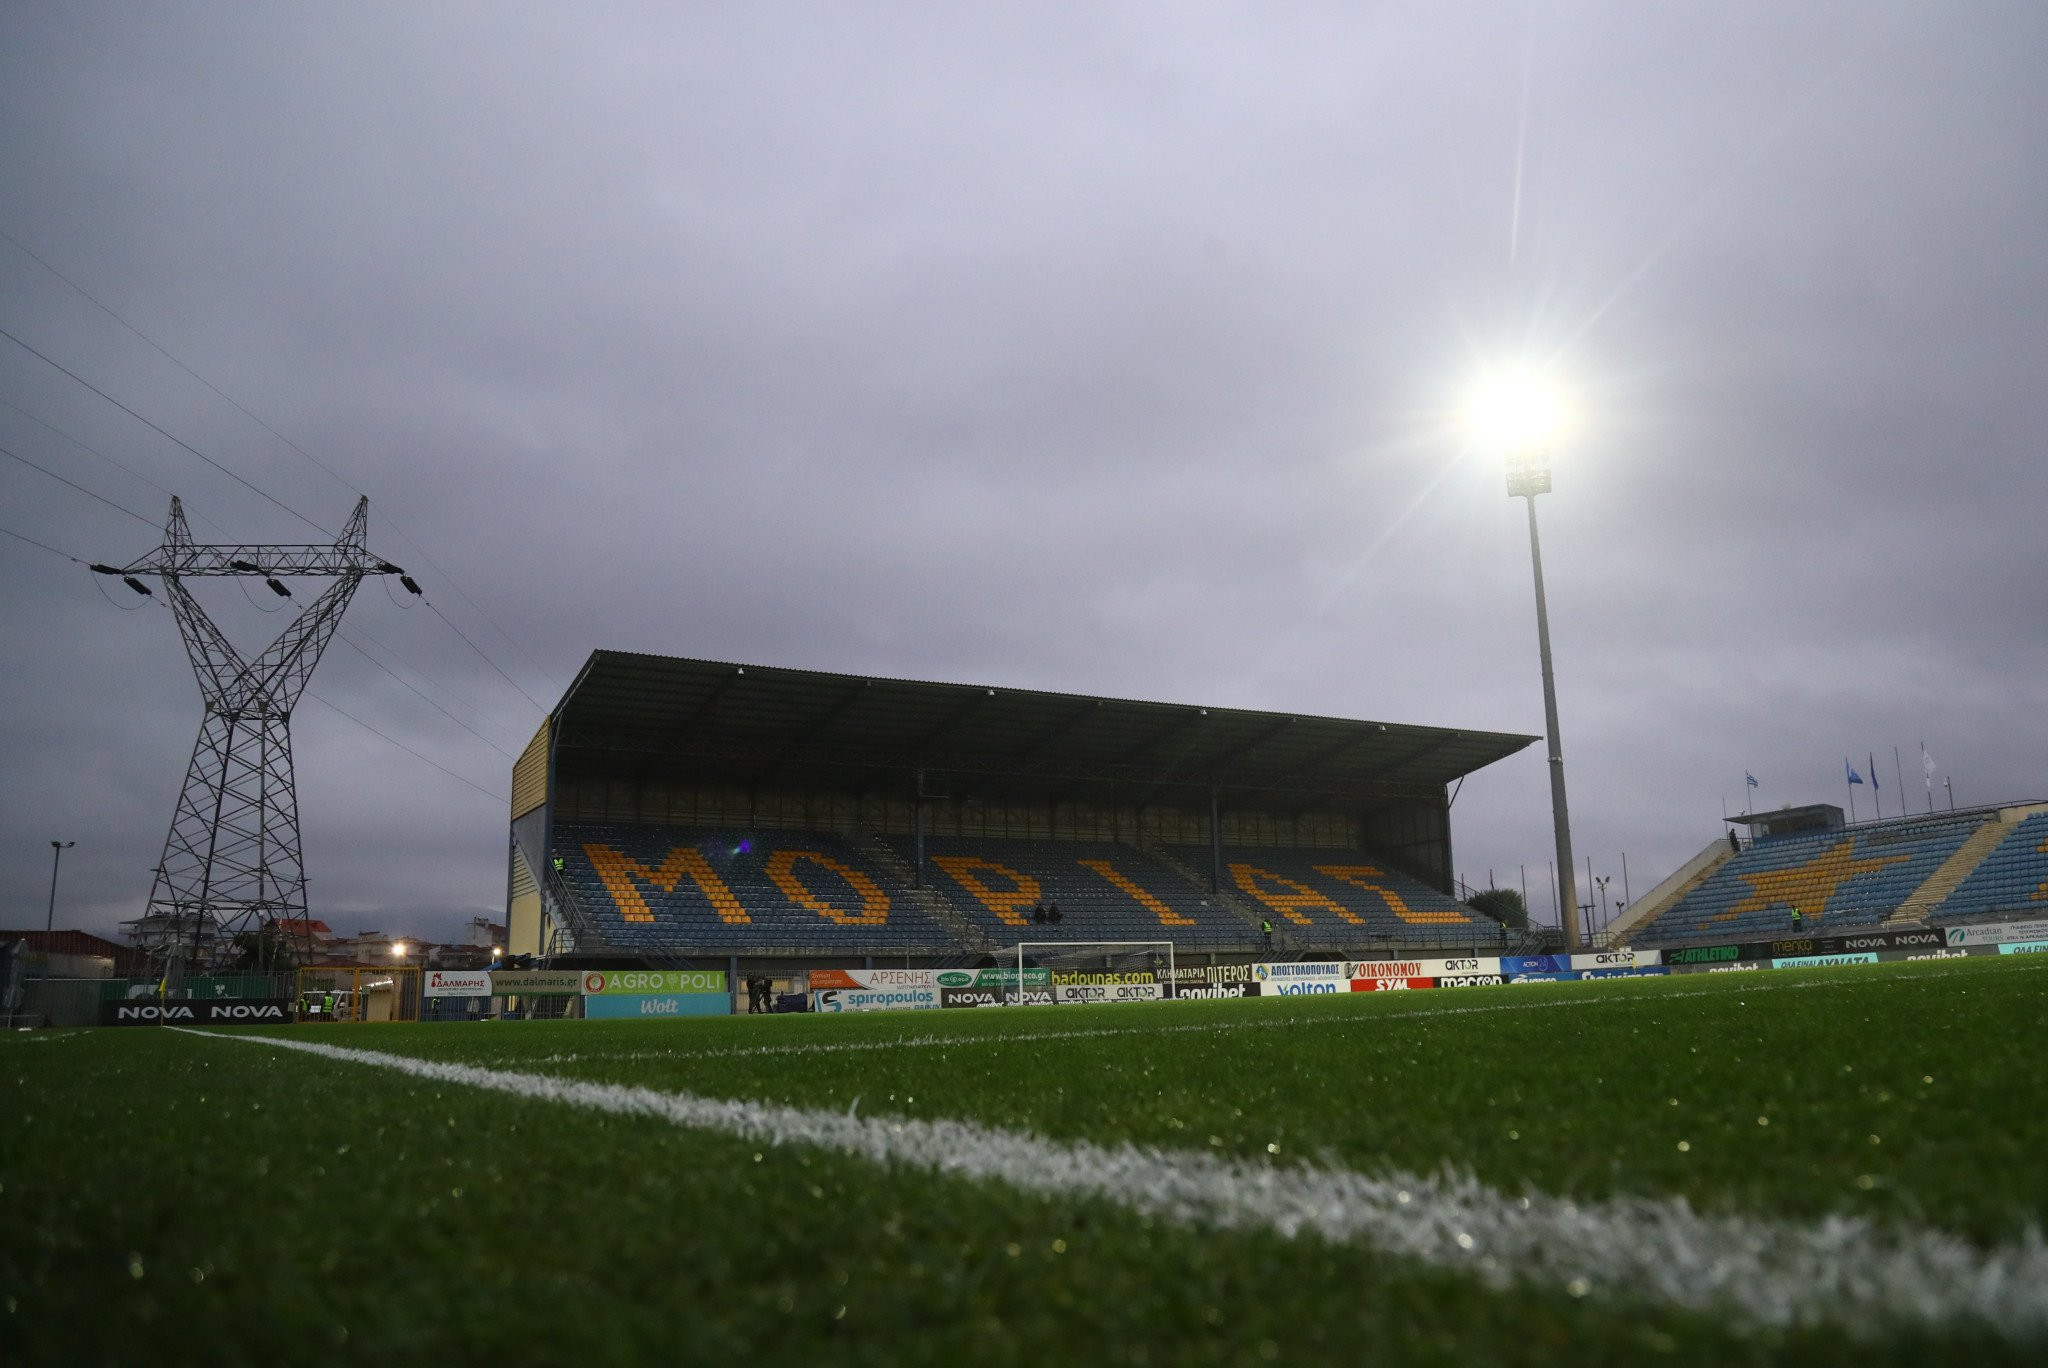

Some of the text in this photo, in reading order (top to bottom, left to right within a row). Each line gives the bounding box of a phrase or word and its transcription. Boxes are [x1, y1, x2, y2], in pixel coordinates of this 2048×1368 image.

[1966, 927, 2003, 938] Arcadian
[1846, 936, 1887, 949] NOVA
[1896, 934, 1940, 946] NOVA
[1206, 964, 1251, 983] ΠΙΤΕΡΟΣ
[1360, 962, 1422, 977] ΟΙΚΟΝΟΜΟΥ
[437, 980, 485, 988] ΔΑΛΜΑΡΗΣ
[496, 976, 577, 989] www.dalmaris.gr
[609, 973, 664, 989] AGRO
[680, 974, 720, 989] POLI
[869, 971, 931, 985] ΑΡΣΕΝΗΣ
[1051, 970, 1154, 986] badounas.com
[1375, 979, 1411, 991] SYM
[848, 990, 933, 1007] spiropoulos
[948, 993, 996, 1004] NOVA
[118, 1005, 284, 1019] NOVA NOVA
[641, 998, 679, 1014] Wolt
